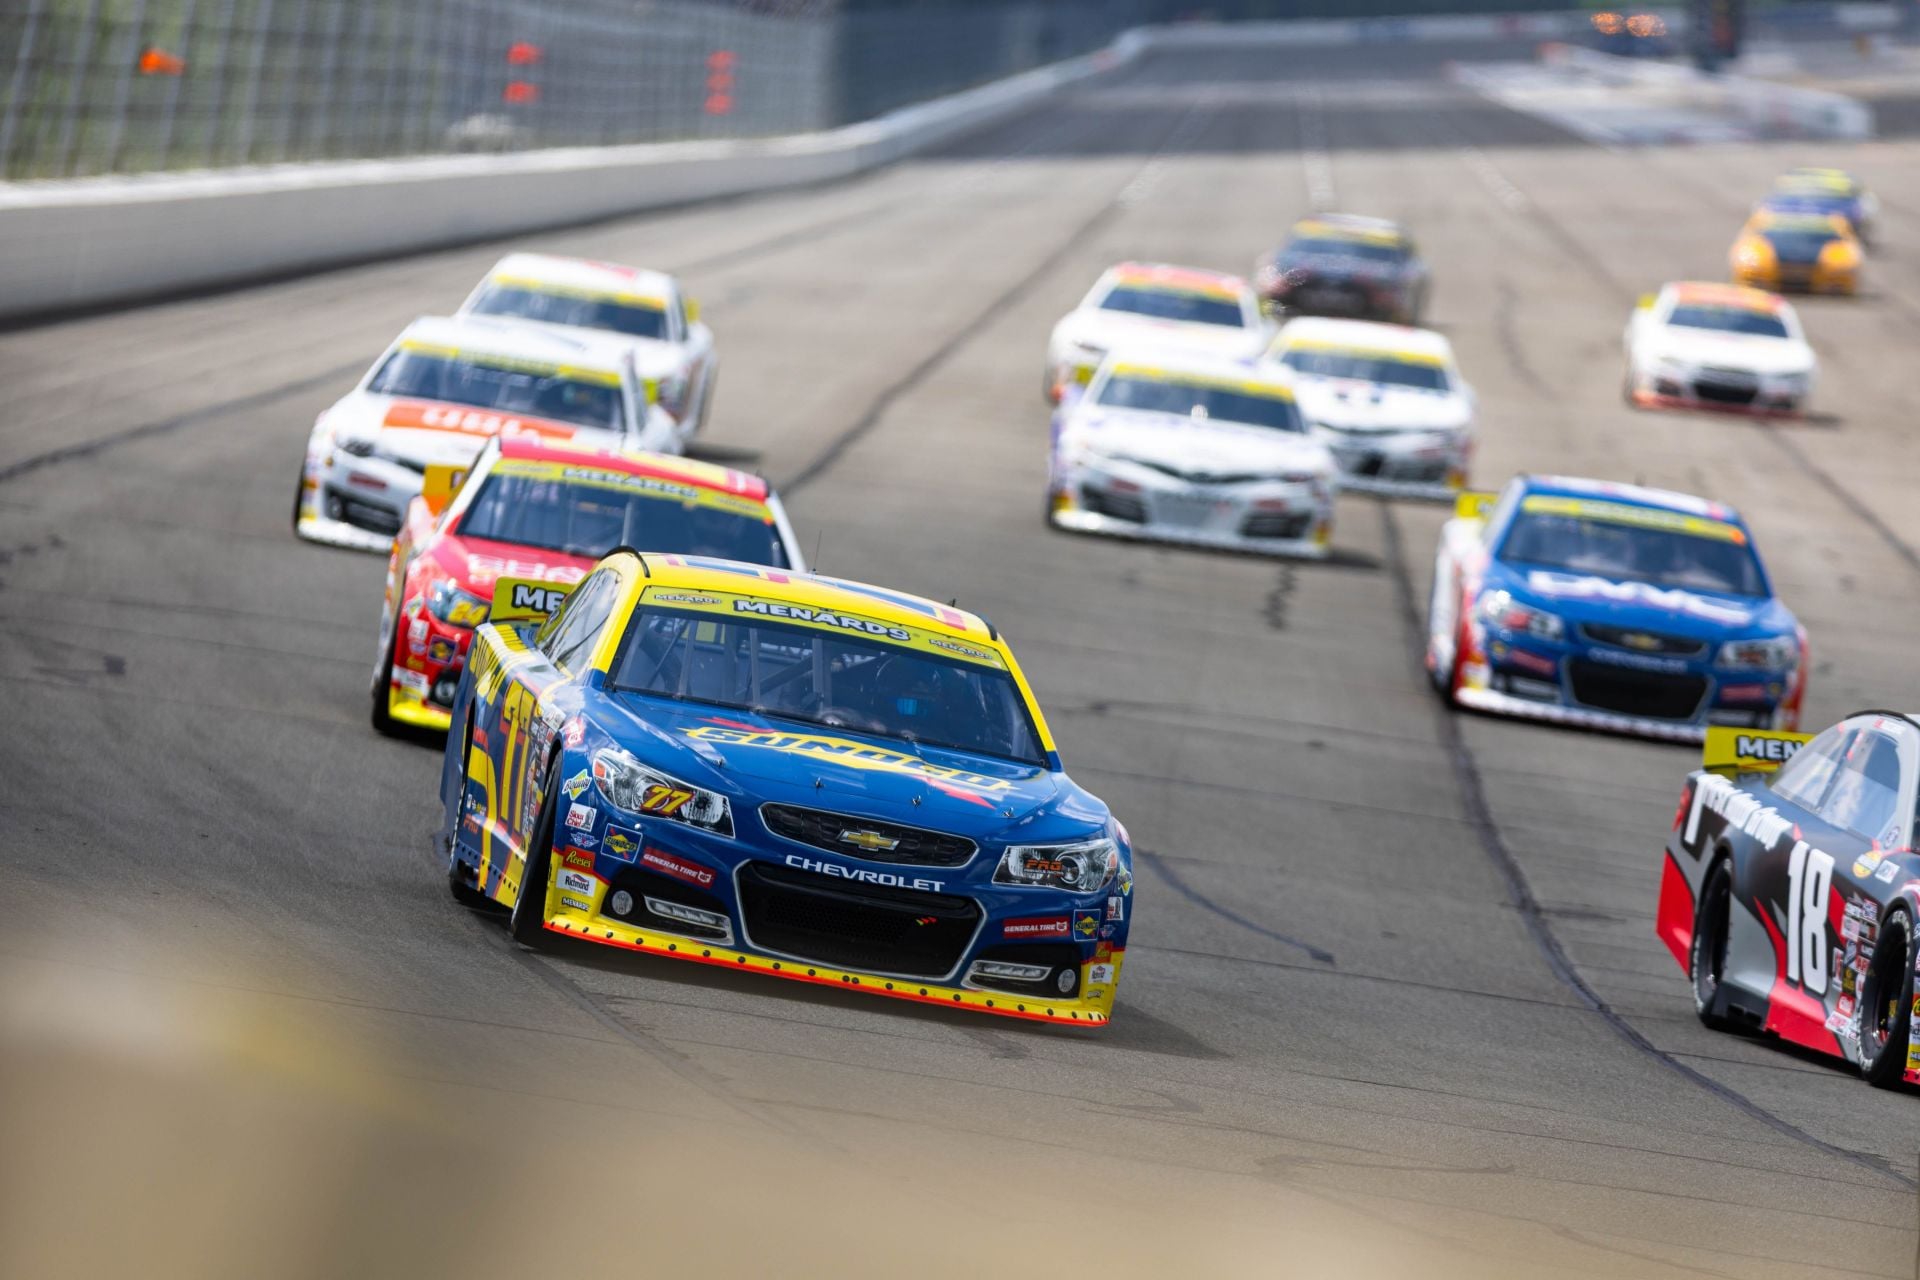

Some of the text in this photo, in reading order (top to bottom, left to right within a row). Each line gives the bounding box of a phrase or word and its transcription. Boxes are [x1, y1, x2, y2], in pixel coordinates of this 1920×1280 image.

[733, 599, 912, 642] MENARDS
[640, 784, 694, 816] 77
[566, 817, 583, 828] Chief
[568, 809, 586, 821] Sioux
[604, 835, 638, 852] SUNOCO
[642, 853, 699, 878] GENERAL TIRE
[785, 854, 945, 892] CHEVROLET
[564, 875, 590, 891] Richmond
[561, 895, 590, 912] MENARDS
[1787, 839, 1835, 996] 18
[1004, 923, 1057, 933] GENERAL TIRE
